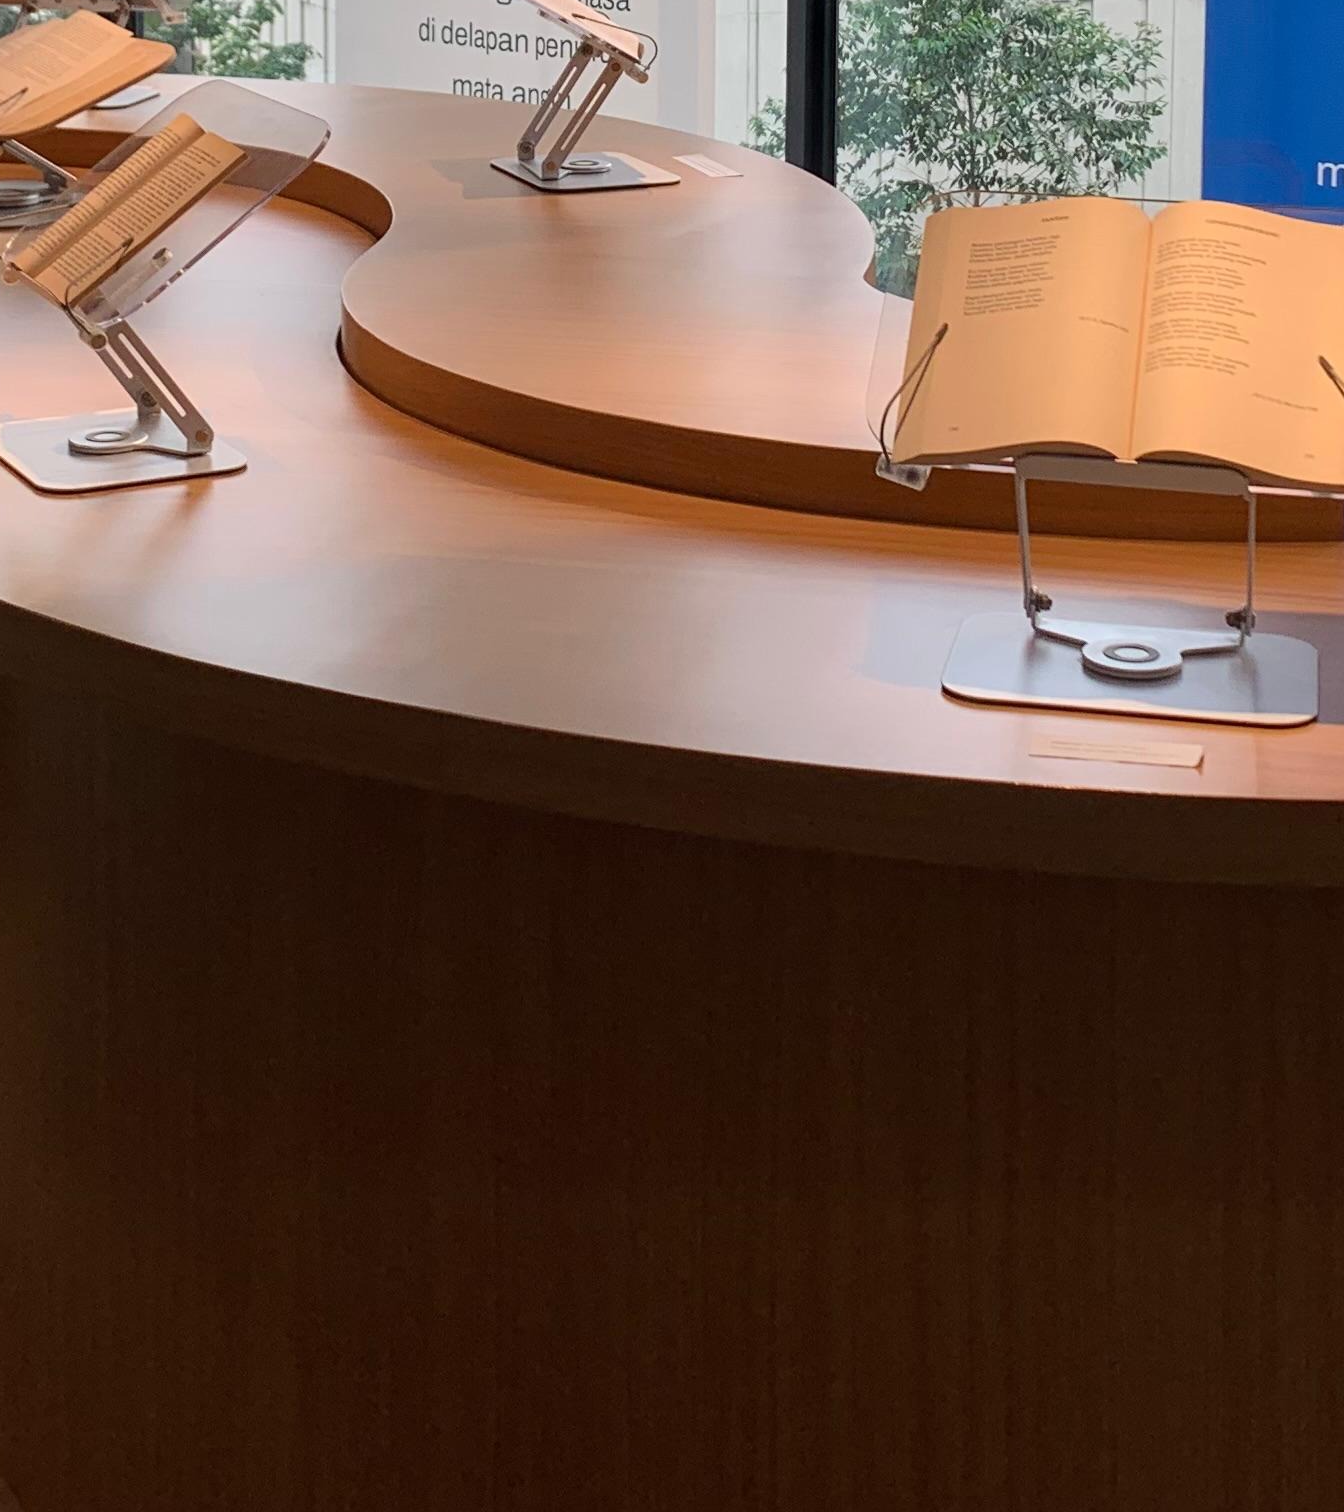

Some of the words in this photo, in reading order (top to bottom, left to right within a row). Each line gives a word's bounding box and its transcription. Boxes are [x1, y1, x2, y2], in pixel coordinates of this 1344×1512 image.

[418, 16, 436, 43] di
[440, 19, 529, 55] delapan
[452, 77, 503, 102] mata
